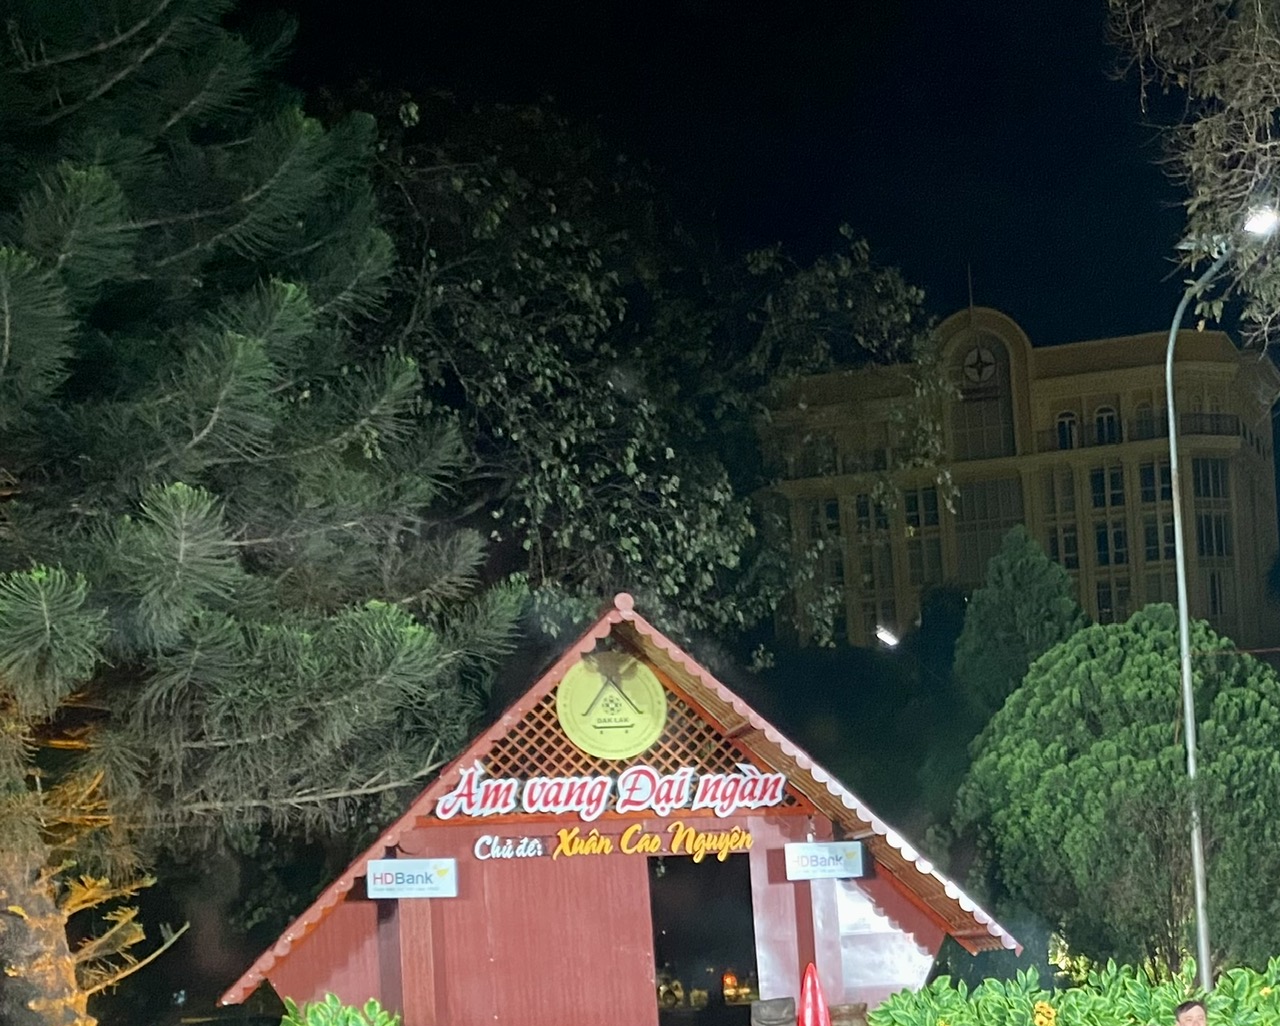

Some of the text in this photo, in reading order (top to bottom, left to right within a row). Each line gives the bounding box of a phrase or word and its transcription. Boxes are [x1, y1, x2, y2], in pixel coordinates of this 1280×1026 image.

[522, 776, 612, 822] vang
[616, 765, 694, 817] Đại
[692, 763, 786, 818] ngàn
[552, 826, 614, 861] Xuân
[620, 823, 662, 855] Cao
[667, 820, 754, 864] Nguyên
[372, 872, 434, 886] HDBank
